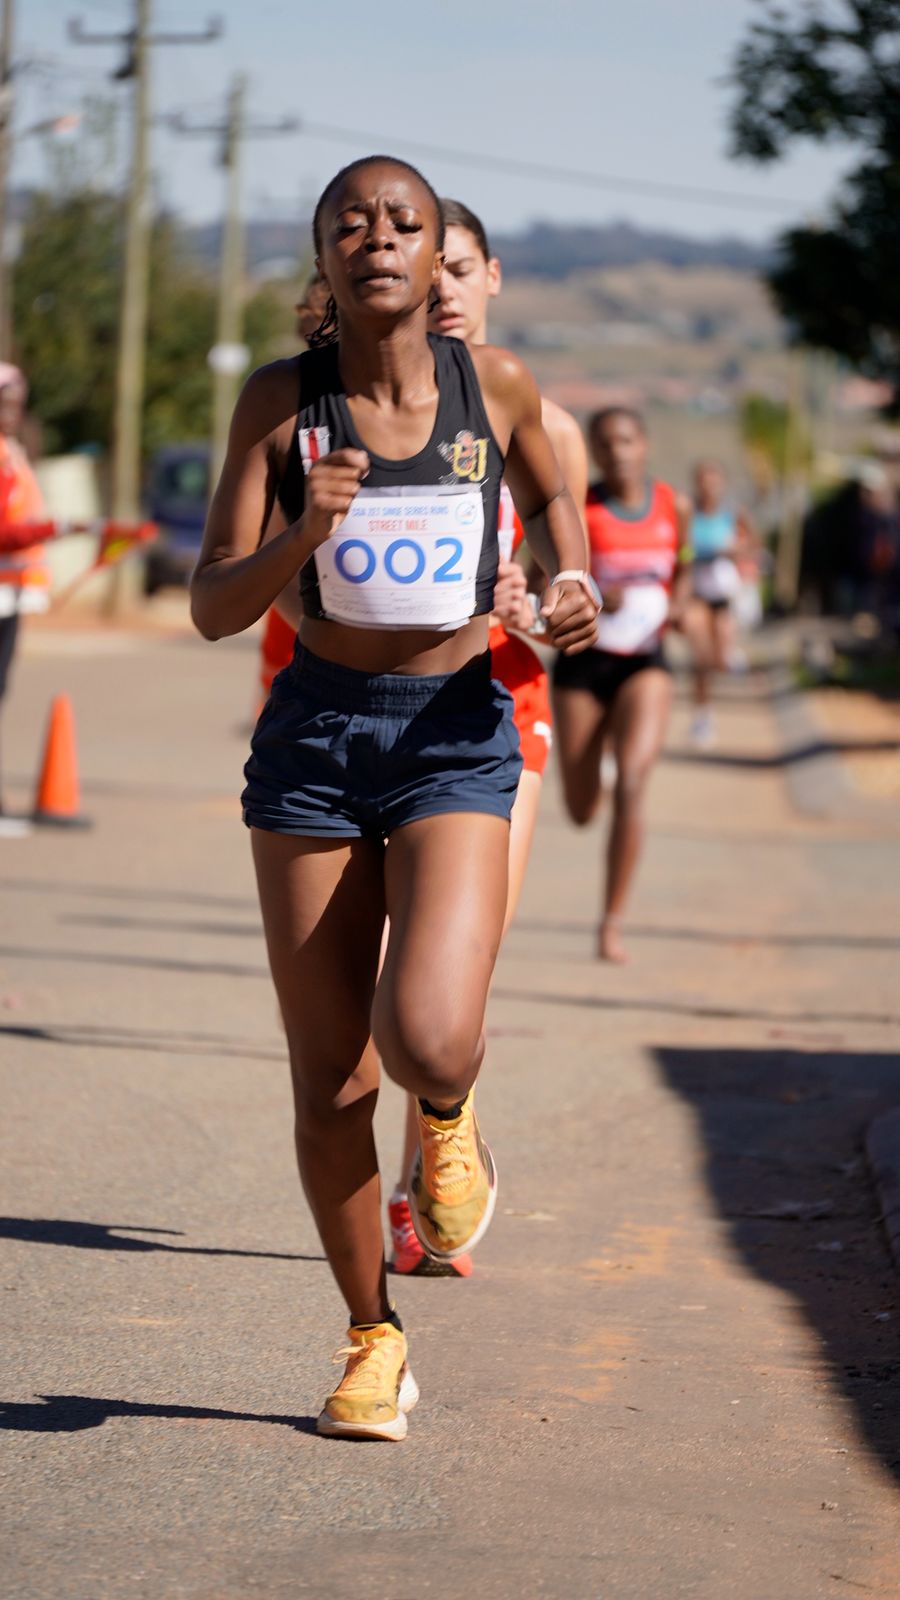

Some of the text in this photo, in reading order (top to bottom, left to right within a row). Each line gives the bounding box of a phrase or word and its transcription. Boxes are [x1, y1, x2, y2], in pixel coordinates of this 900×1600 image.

[368, 518, 428, 532] STREET MILE
[334, 536, 464, 584] 002
